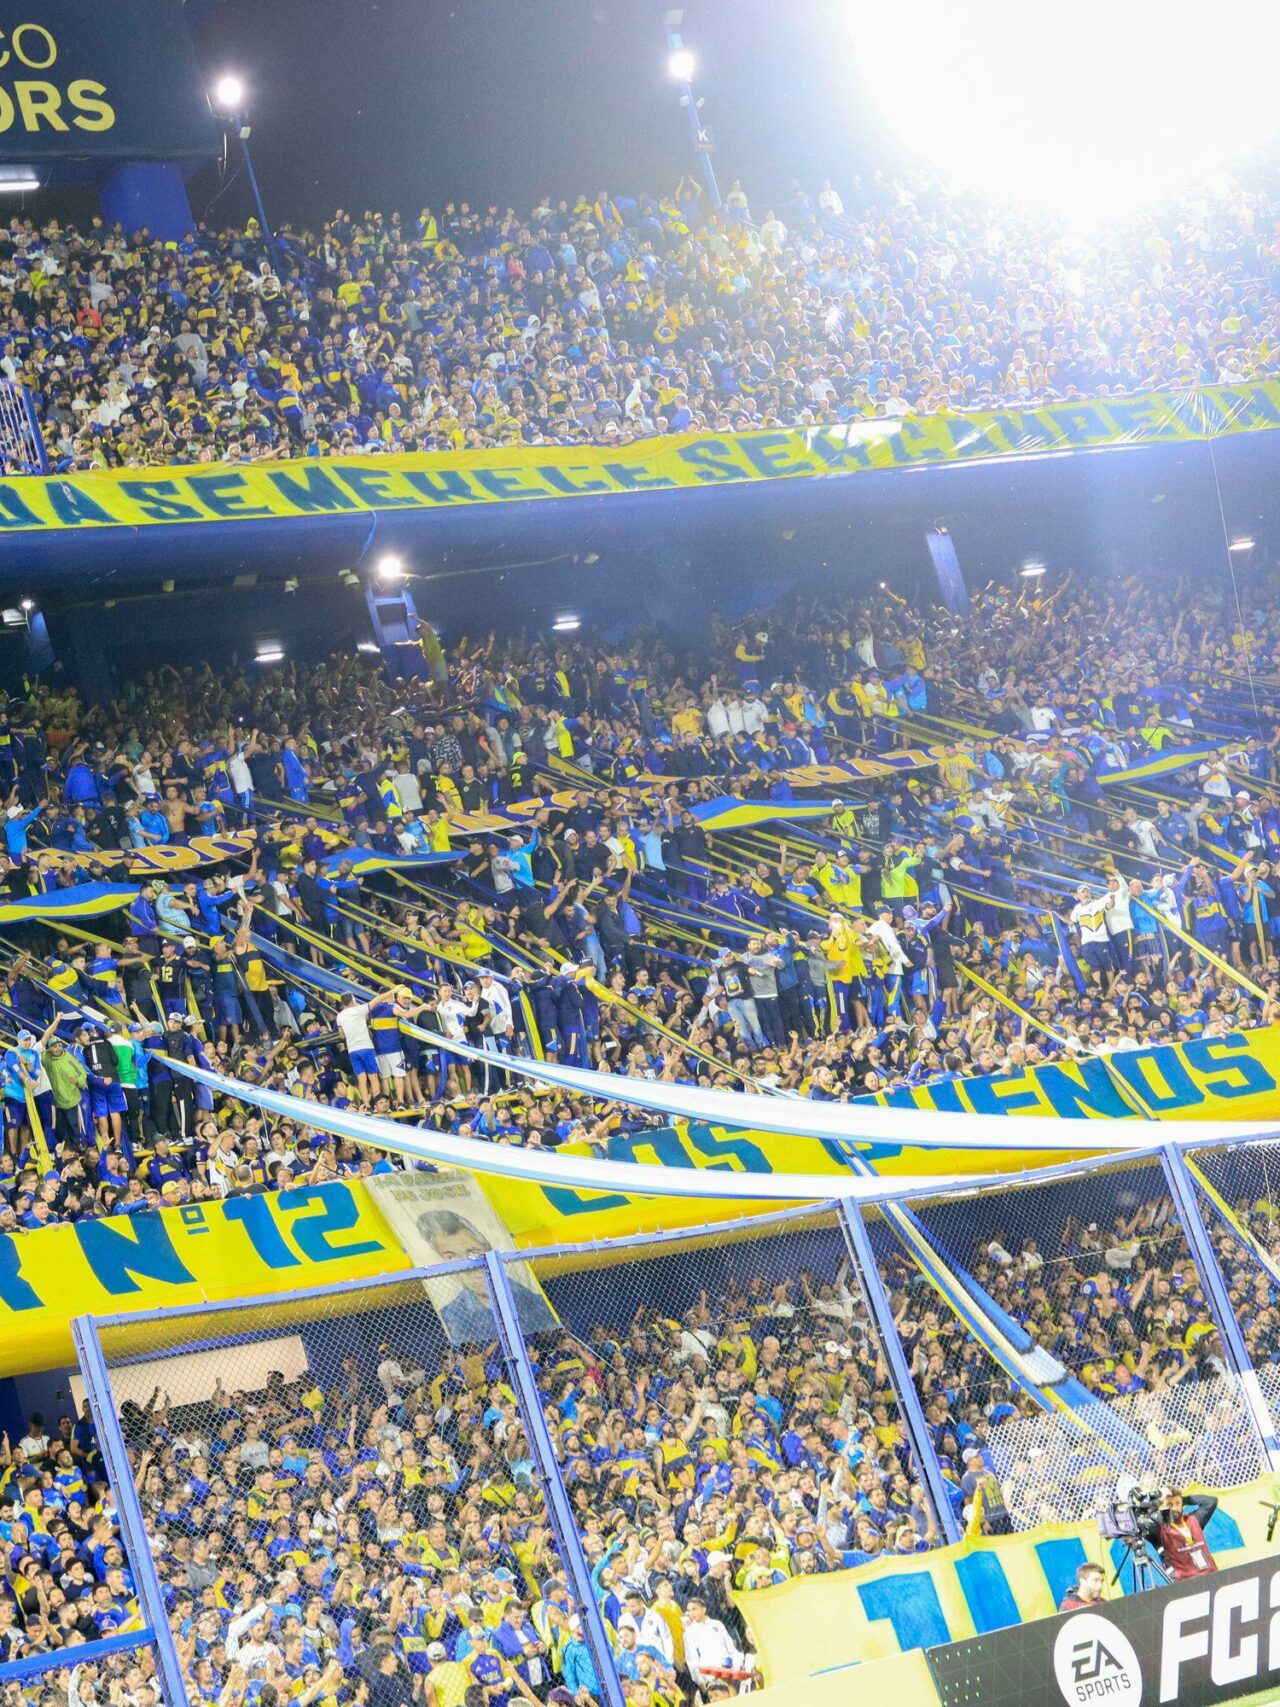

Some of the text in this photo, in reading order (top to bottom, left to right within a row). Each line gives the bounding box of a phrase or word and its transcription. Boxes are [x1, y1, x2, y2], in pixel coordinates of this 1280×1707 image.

[120, 471, 276, 521] SE
[265, 462, 676, 513] MERECE
[160, 965, 174, 984] 12
[223, 1178, 387, 1271] 12
[1071, 1639, 1124, 1684] EA
[1159, 1570, 1280, 1704] FC
[1075, 1672, 1132, 1702] SPORTS
